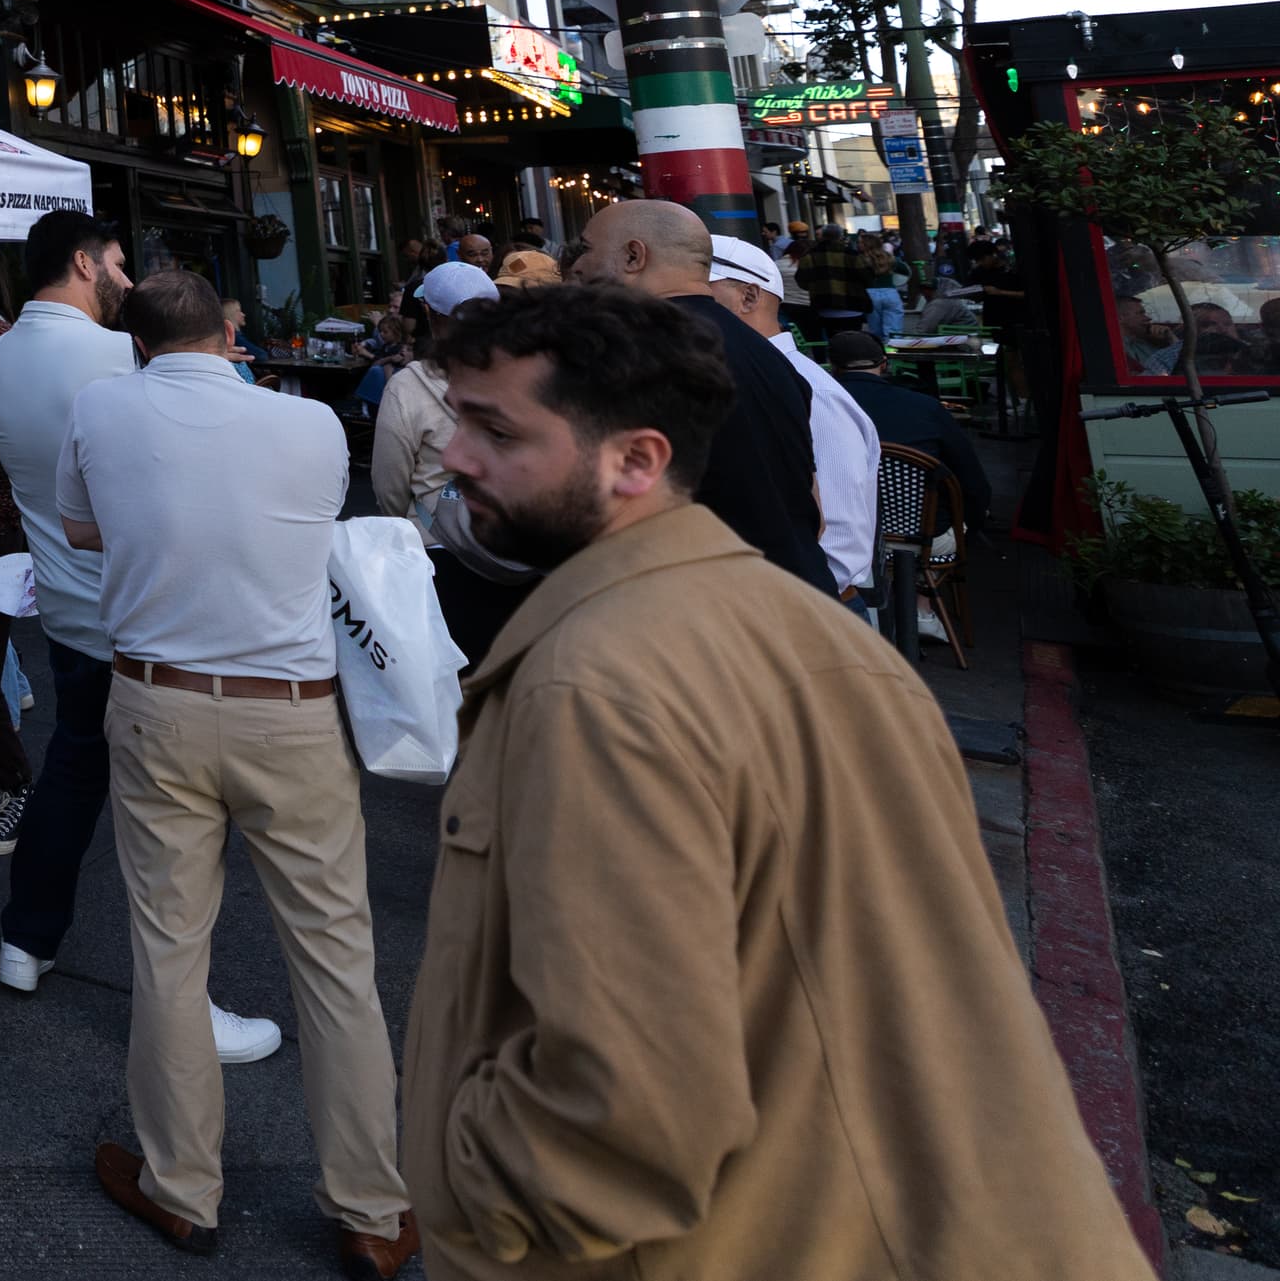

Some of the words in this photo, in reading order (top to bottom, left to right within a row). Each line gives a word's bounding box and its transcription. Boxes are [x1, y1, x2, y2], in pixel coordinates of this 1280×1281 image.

[340, 70, 380, 104] TONY'S
[379, 83, 411, 112] PIZZA
[804, 82, 863, 100] Nik's
[808, 100, 889, 122] CAFE
[6, 193, 32, 209] PIZZA
